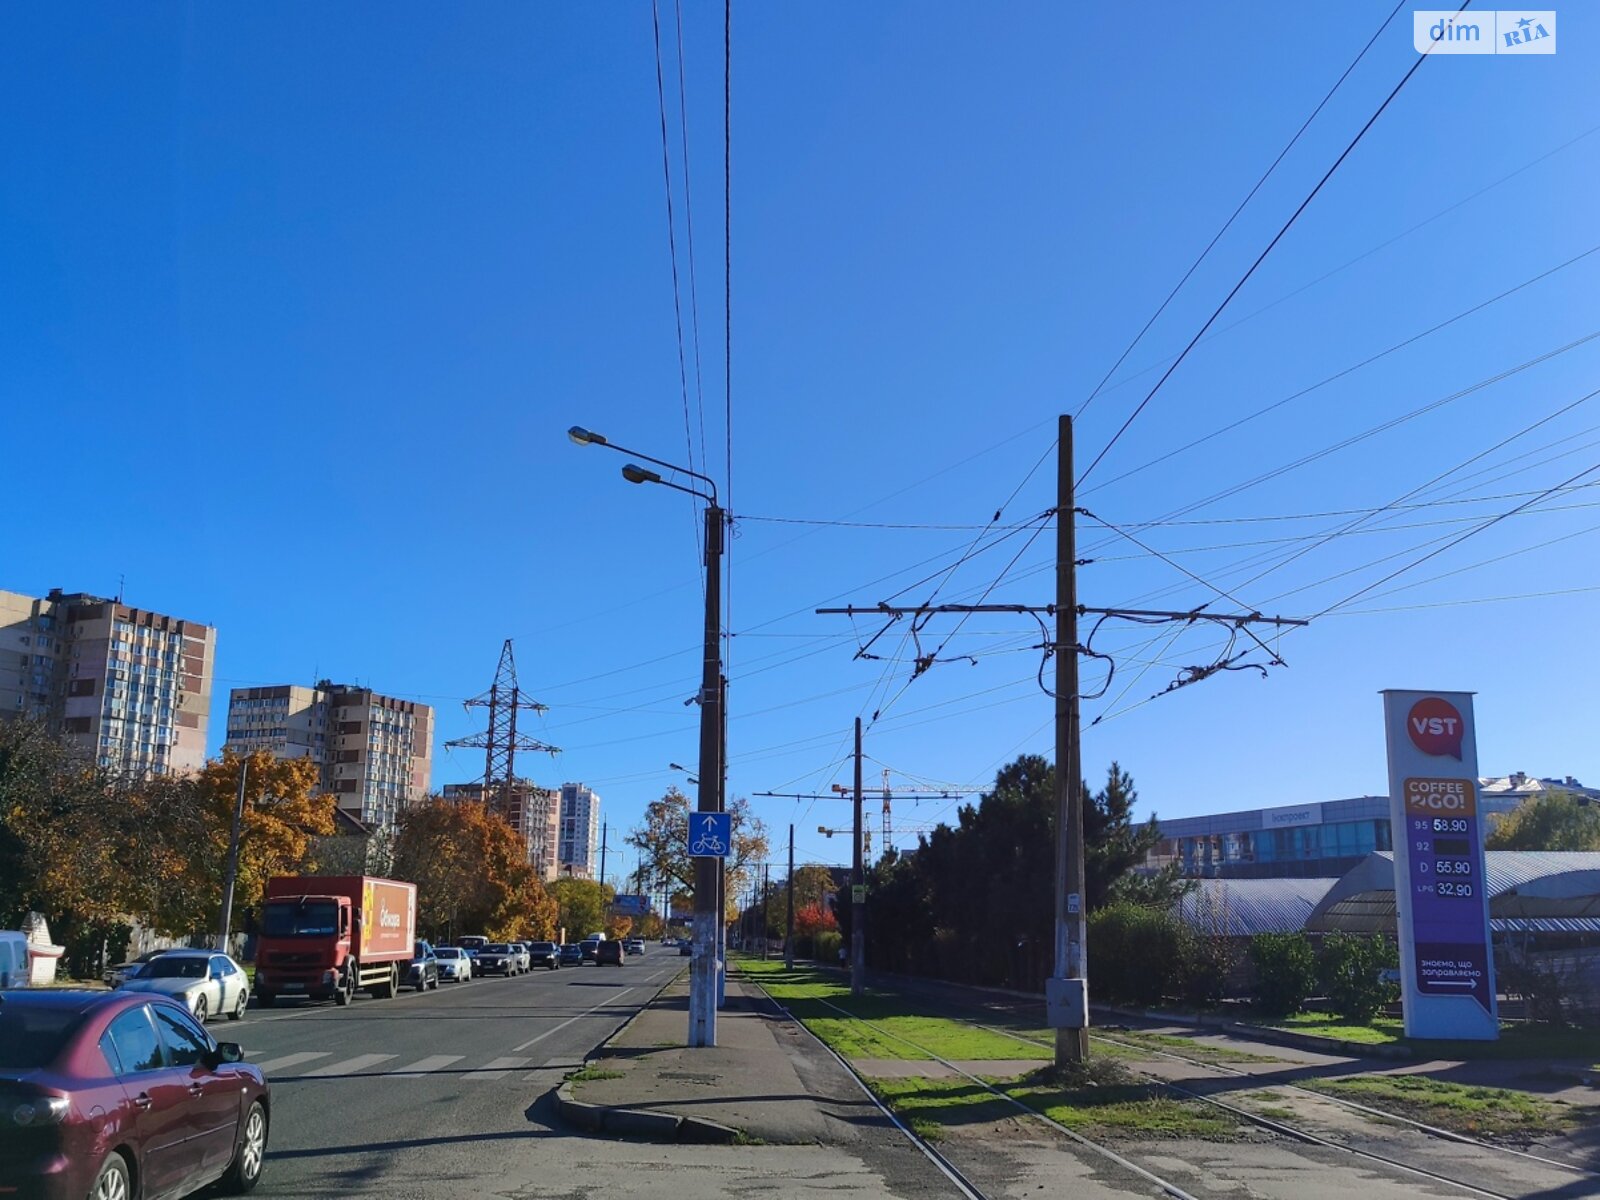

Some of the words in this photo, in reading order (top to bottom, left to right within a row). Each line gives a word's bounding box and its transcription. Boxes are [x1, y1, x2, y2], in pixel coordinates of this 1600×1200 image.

[1412, 716, 1457, 736] VST
[1408, 781, 1464, 793] COFFEE
[1415, 821, 1428, 830] 95
[1433, 818, 1467, 832] 58.90
[1416, 842, 1429, 851] 92
[1420, 862, 1429, 873] D
[1436, 861, 1470, 874] 55.90
[1417, 885, 1434, 893] LPG
[1437, 882, 1472, 897] 32.90
